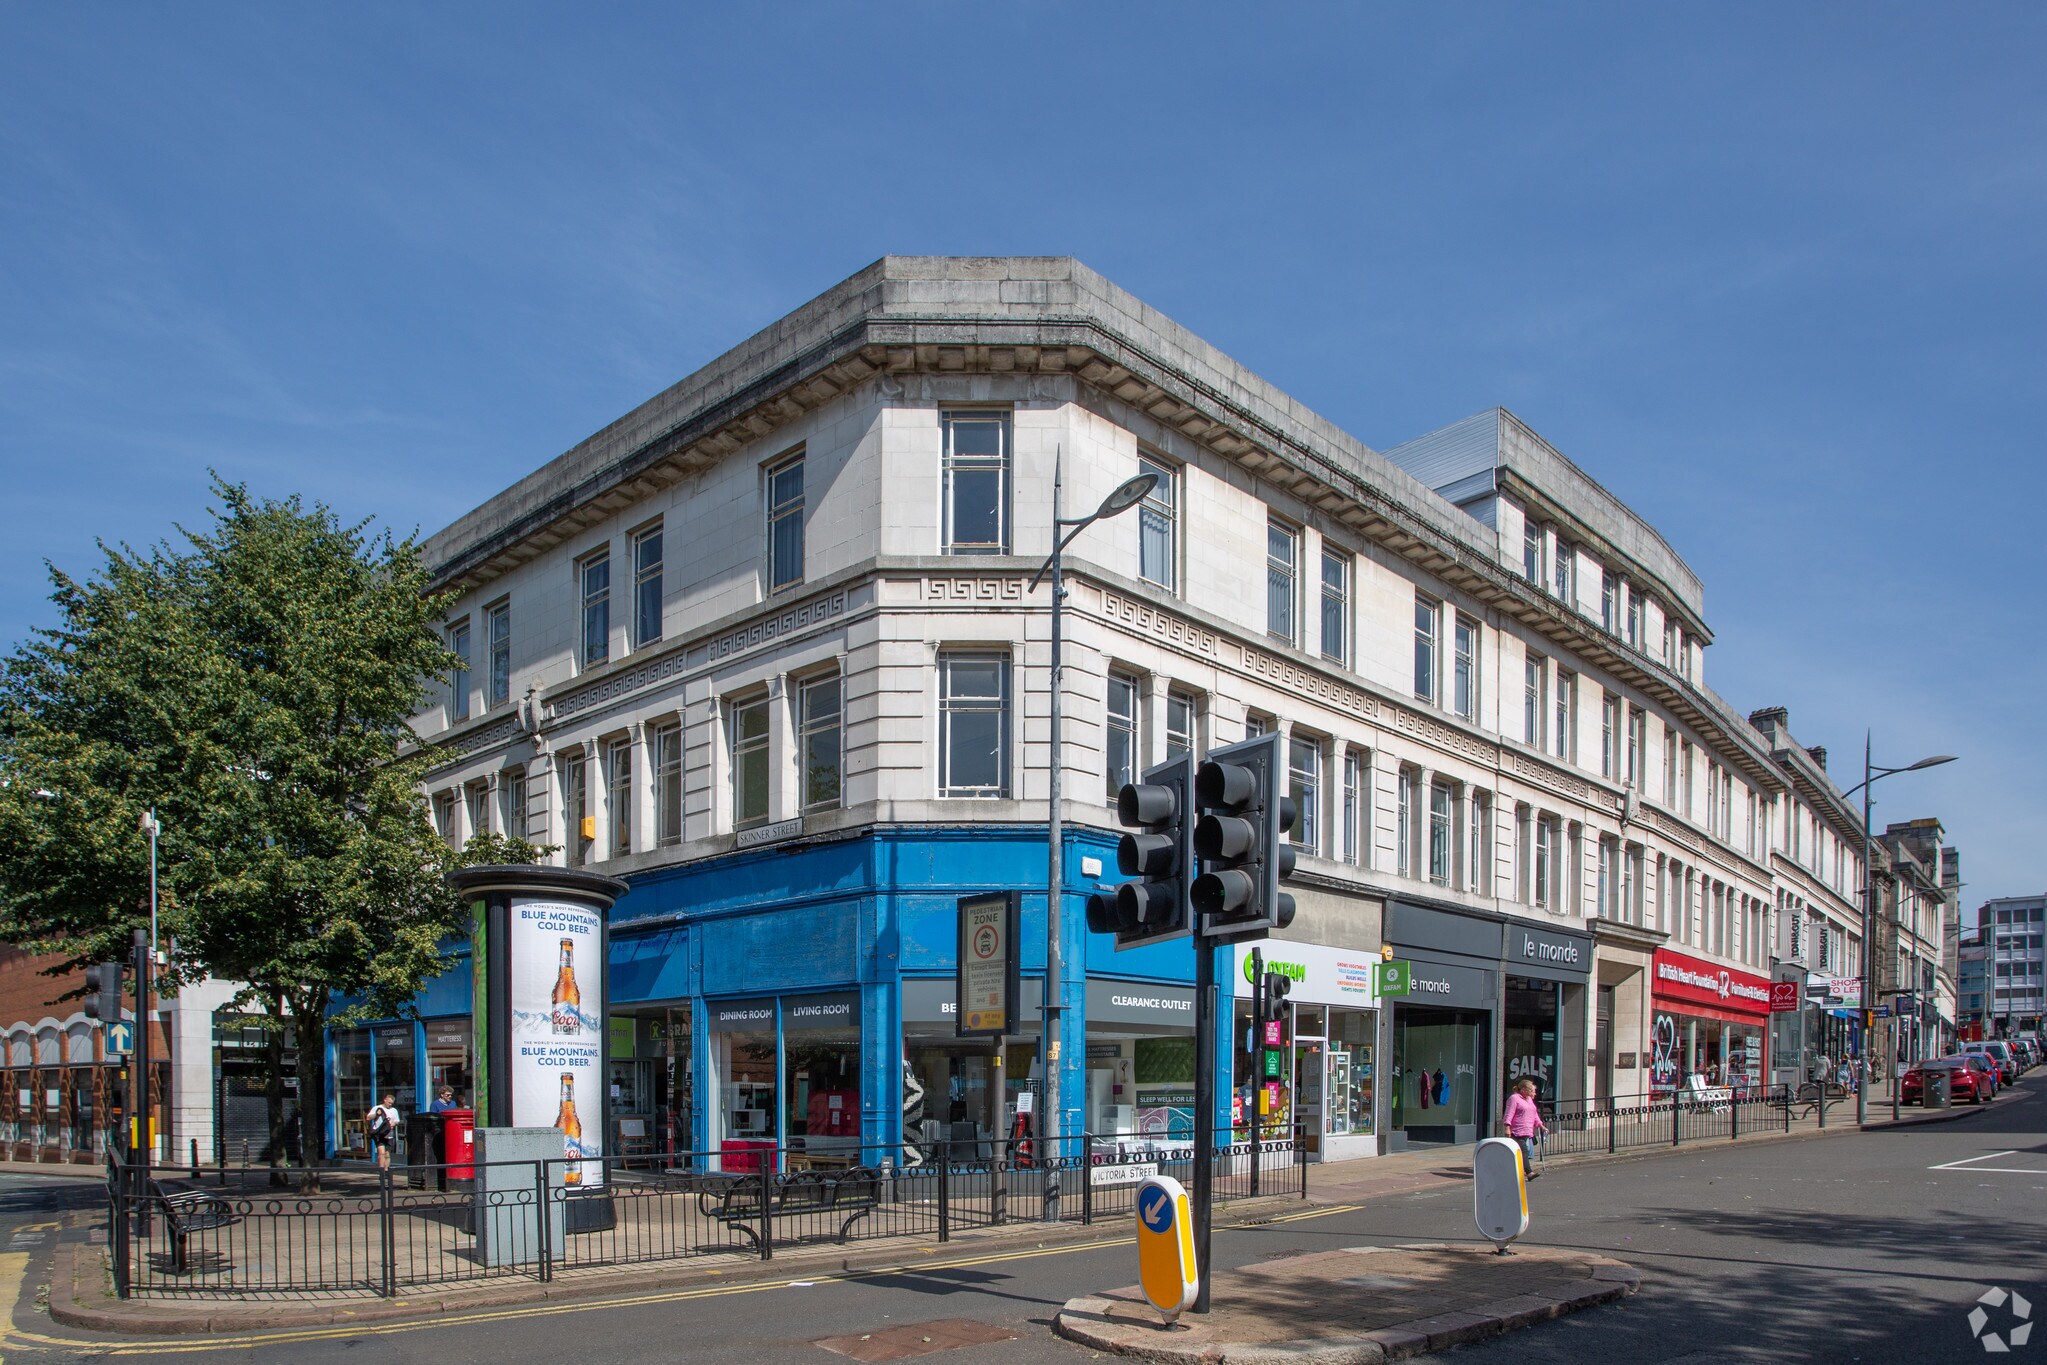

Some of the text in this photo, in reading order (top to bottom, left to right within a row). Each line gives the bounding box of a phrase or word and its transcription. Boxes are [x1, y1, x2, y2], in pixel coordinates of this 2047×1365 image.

[740, 822, 799, 844] SKINNER STREET
[970, 905, 1004, 915] PEDESTRIAN
[521, 910, 546, 919] BLUE
[549, 912, 599, 928] MOUNTAINS.
[974, 913, 999, 925] ZONE
[538, 921, 591, 935] COLD BEER.
[1791, 914, 1800, 957] TONI&GUY
[1522, 933, 1578, 963] le monde
[1820, 928, 1828, 968] TONI&GUY
[1267, 960, 1306, 983] OXFAM
[1658, 963, 1719, 991] British Heart Foundation
[1384, 984, 1402, 992] OXFAM
[1419, 976, 1450, 993] monde
[1111, 995, 1192, 1010] CLEARANCE OUTLET
[720, 1009, 773, 1021] DINING ROOM
[793, 1004, 850, 1017] LIVING ROOM
[556, 1025, 578, 1033] LIGHT
[438, 1034, 462, 1043] MATTERESS
[521, 1047, 599, 1058] BLUE MOUNTAINS.
[538, 1057, 591, 1067] COLD BEER.
[1509, 1055, 1548, 1081] SALE
[1456, 1064, 1474, 1075] SALE
[1094, 1166, 1157, 1181] VICTORIA STREET
